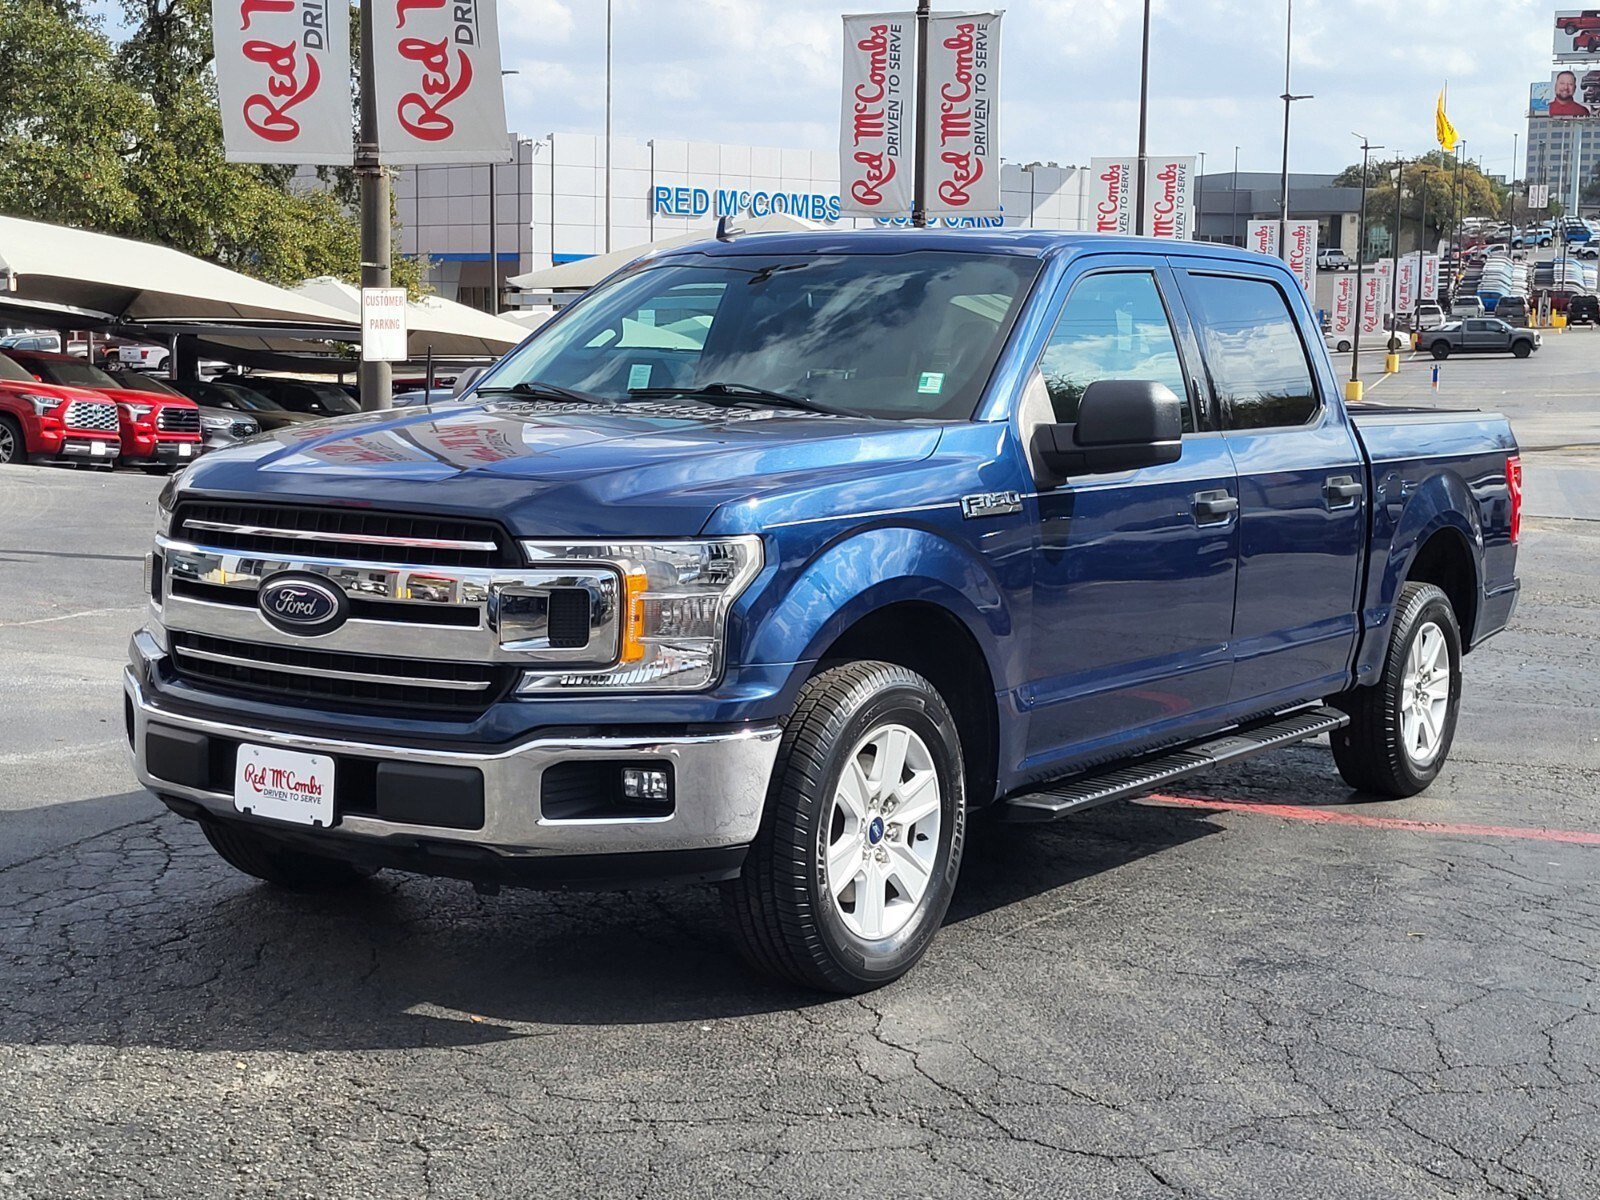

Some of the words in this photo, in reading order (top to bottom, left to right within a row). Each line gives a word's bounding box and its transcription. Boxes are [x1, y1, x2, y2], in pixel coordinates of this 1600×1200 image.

[889, 23, 902, 70] SERVE
[976, 23, 989, 69] SERVE
[242, 40, 321, 142] Red
[397, 36, 473, 141] Red
[853, 24, 888, 147] McCombs
[888, 74, 900, 95] TO
[940, 23, 975, 147] McCombs
[975, 73, 987, 95] TO
[887, 100, 900, 156] DRIVEN
[974, 99, 986, 156] DRIVEN
[851, 151, 896, 205] Red
[938, 151, 983, 206] Red
[1121, 164, 1130, 194] SERVE
[1177, 163, 1187, 193] SERVE
[655, 186, 711, 214] RED
[1120, 196, 1128, 209] TO
[1176, 196, 1185, 209] TO
[365, 295, 404, 307] CUSTOMER
[369, 318, 401, 330] PARKING
[275, 588, 318, 616] Ford
[244, 763, 268, 793] Red
[268, 767, 322, 796] McCombs
[263, 788, 288, 799] DRIVEN
[289, 793, 299, 801] TO
[300, 794, 322, 805] SERVE
